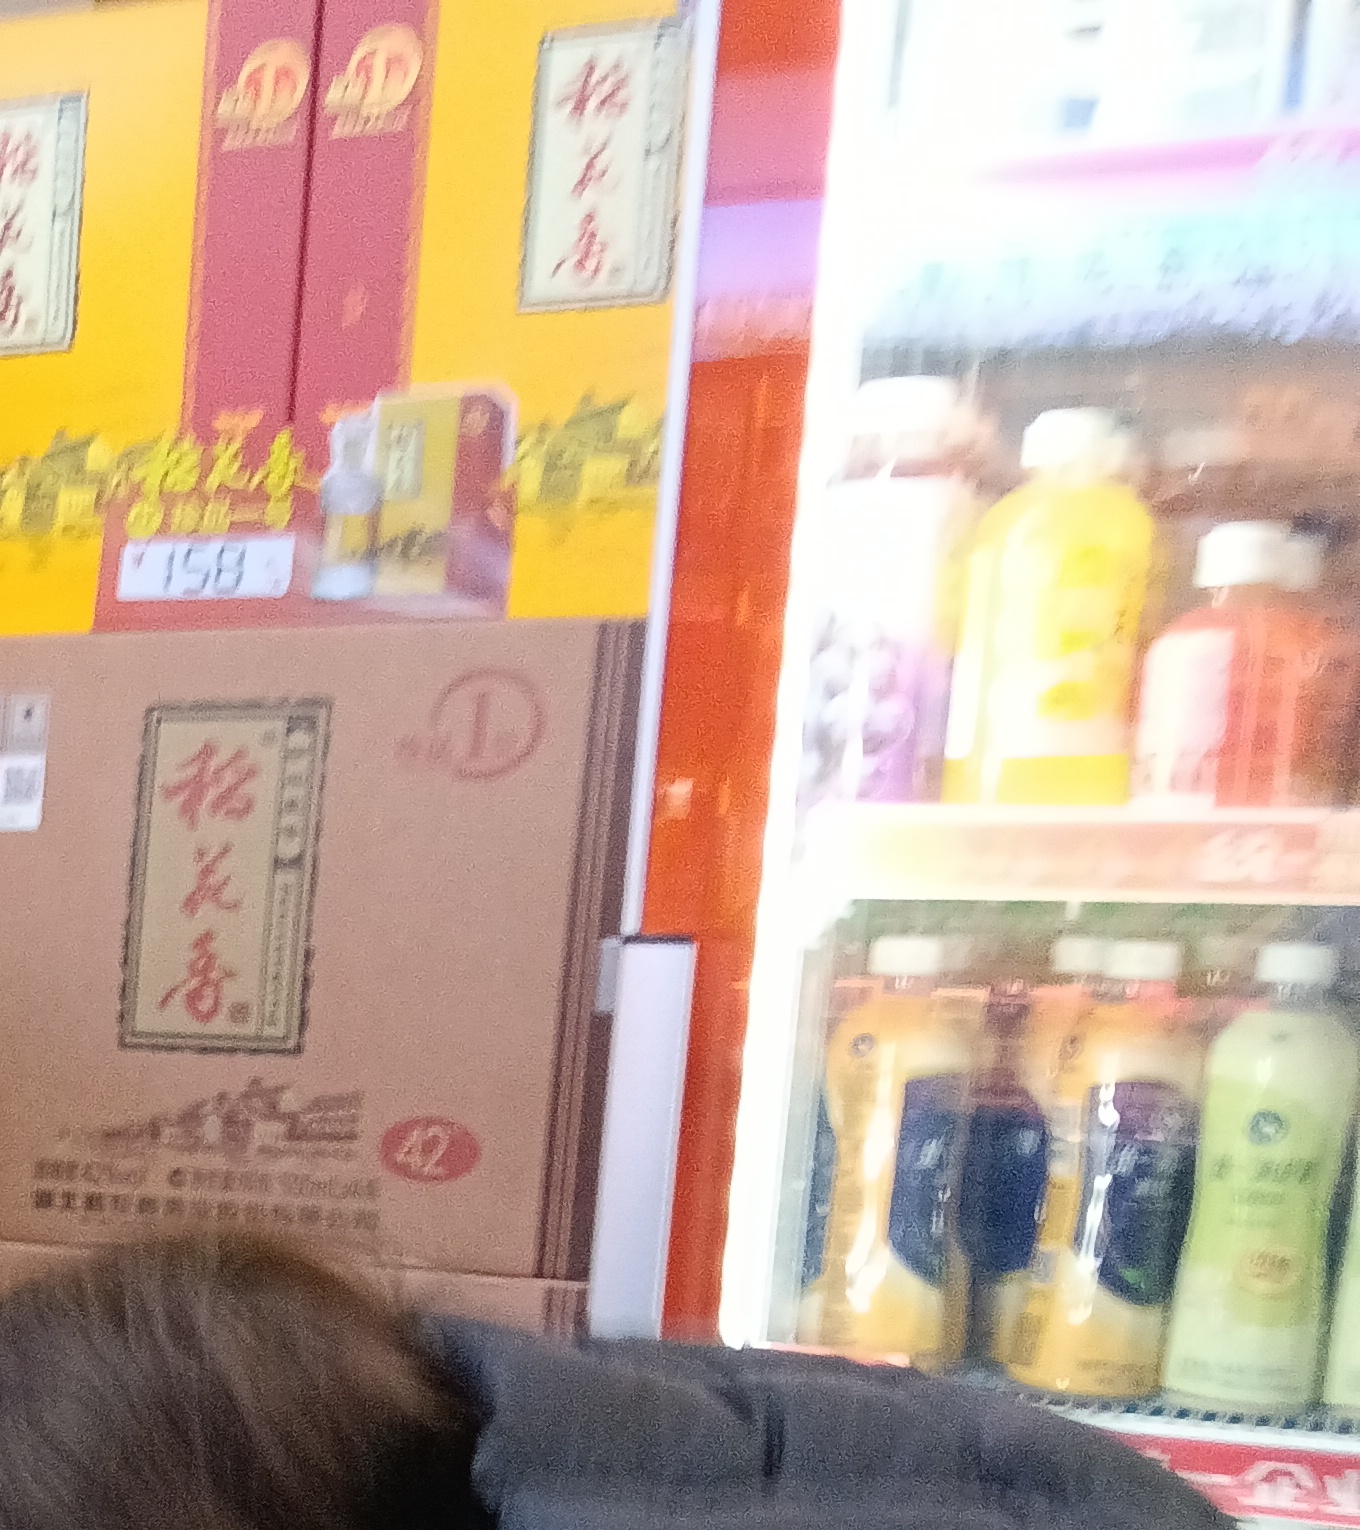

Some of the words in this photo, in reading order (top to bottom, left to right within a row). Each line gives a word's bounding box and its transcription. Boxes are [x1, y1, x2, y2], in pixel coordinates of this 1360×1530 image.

[160, 541, 249, 595] 158
[160, 741, 260, 1024] 稻花香
[395, 1125, 454, 1178] 42
